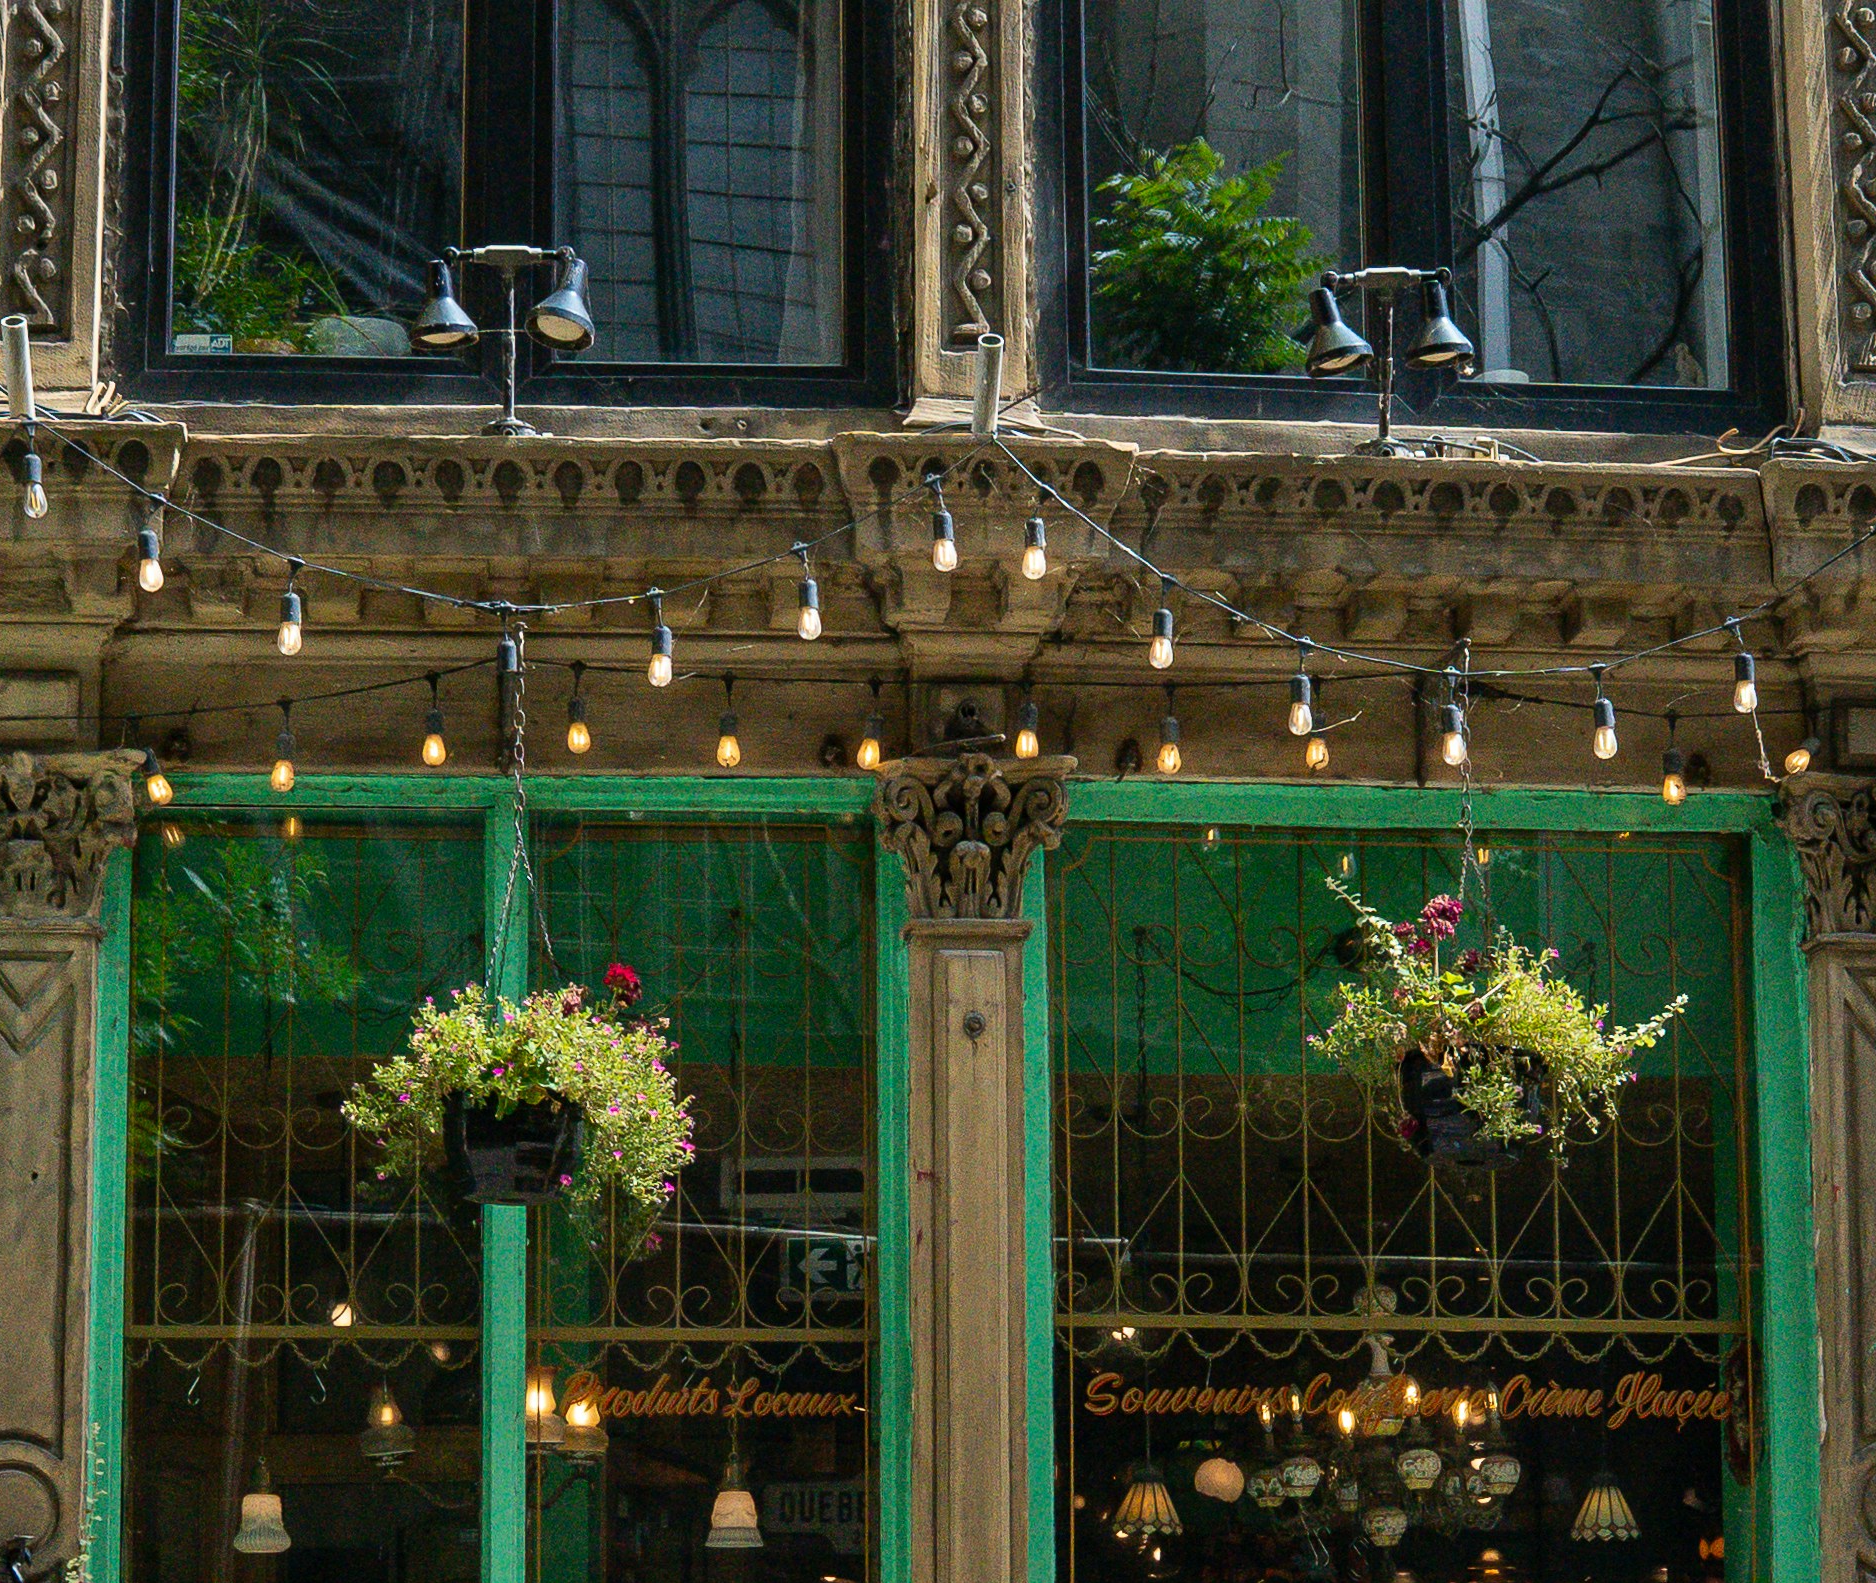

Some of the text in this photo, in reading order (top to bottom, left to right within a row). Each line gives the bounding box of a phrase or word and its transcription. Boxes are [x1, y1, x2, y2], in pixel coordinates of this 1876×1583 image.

[561, 1370, 859, 1418] Produits Locaux
[1084, 1372, 1291, 1417] Souvenirs
[1500, 1373, 1604, 1420] Crème
[1606, 1370, 1732, 1433] Glacée
